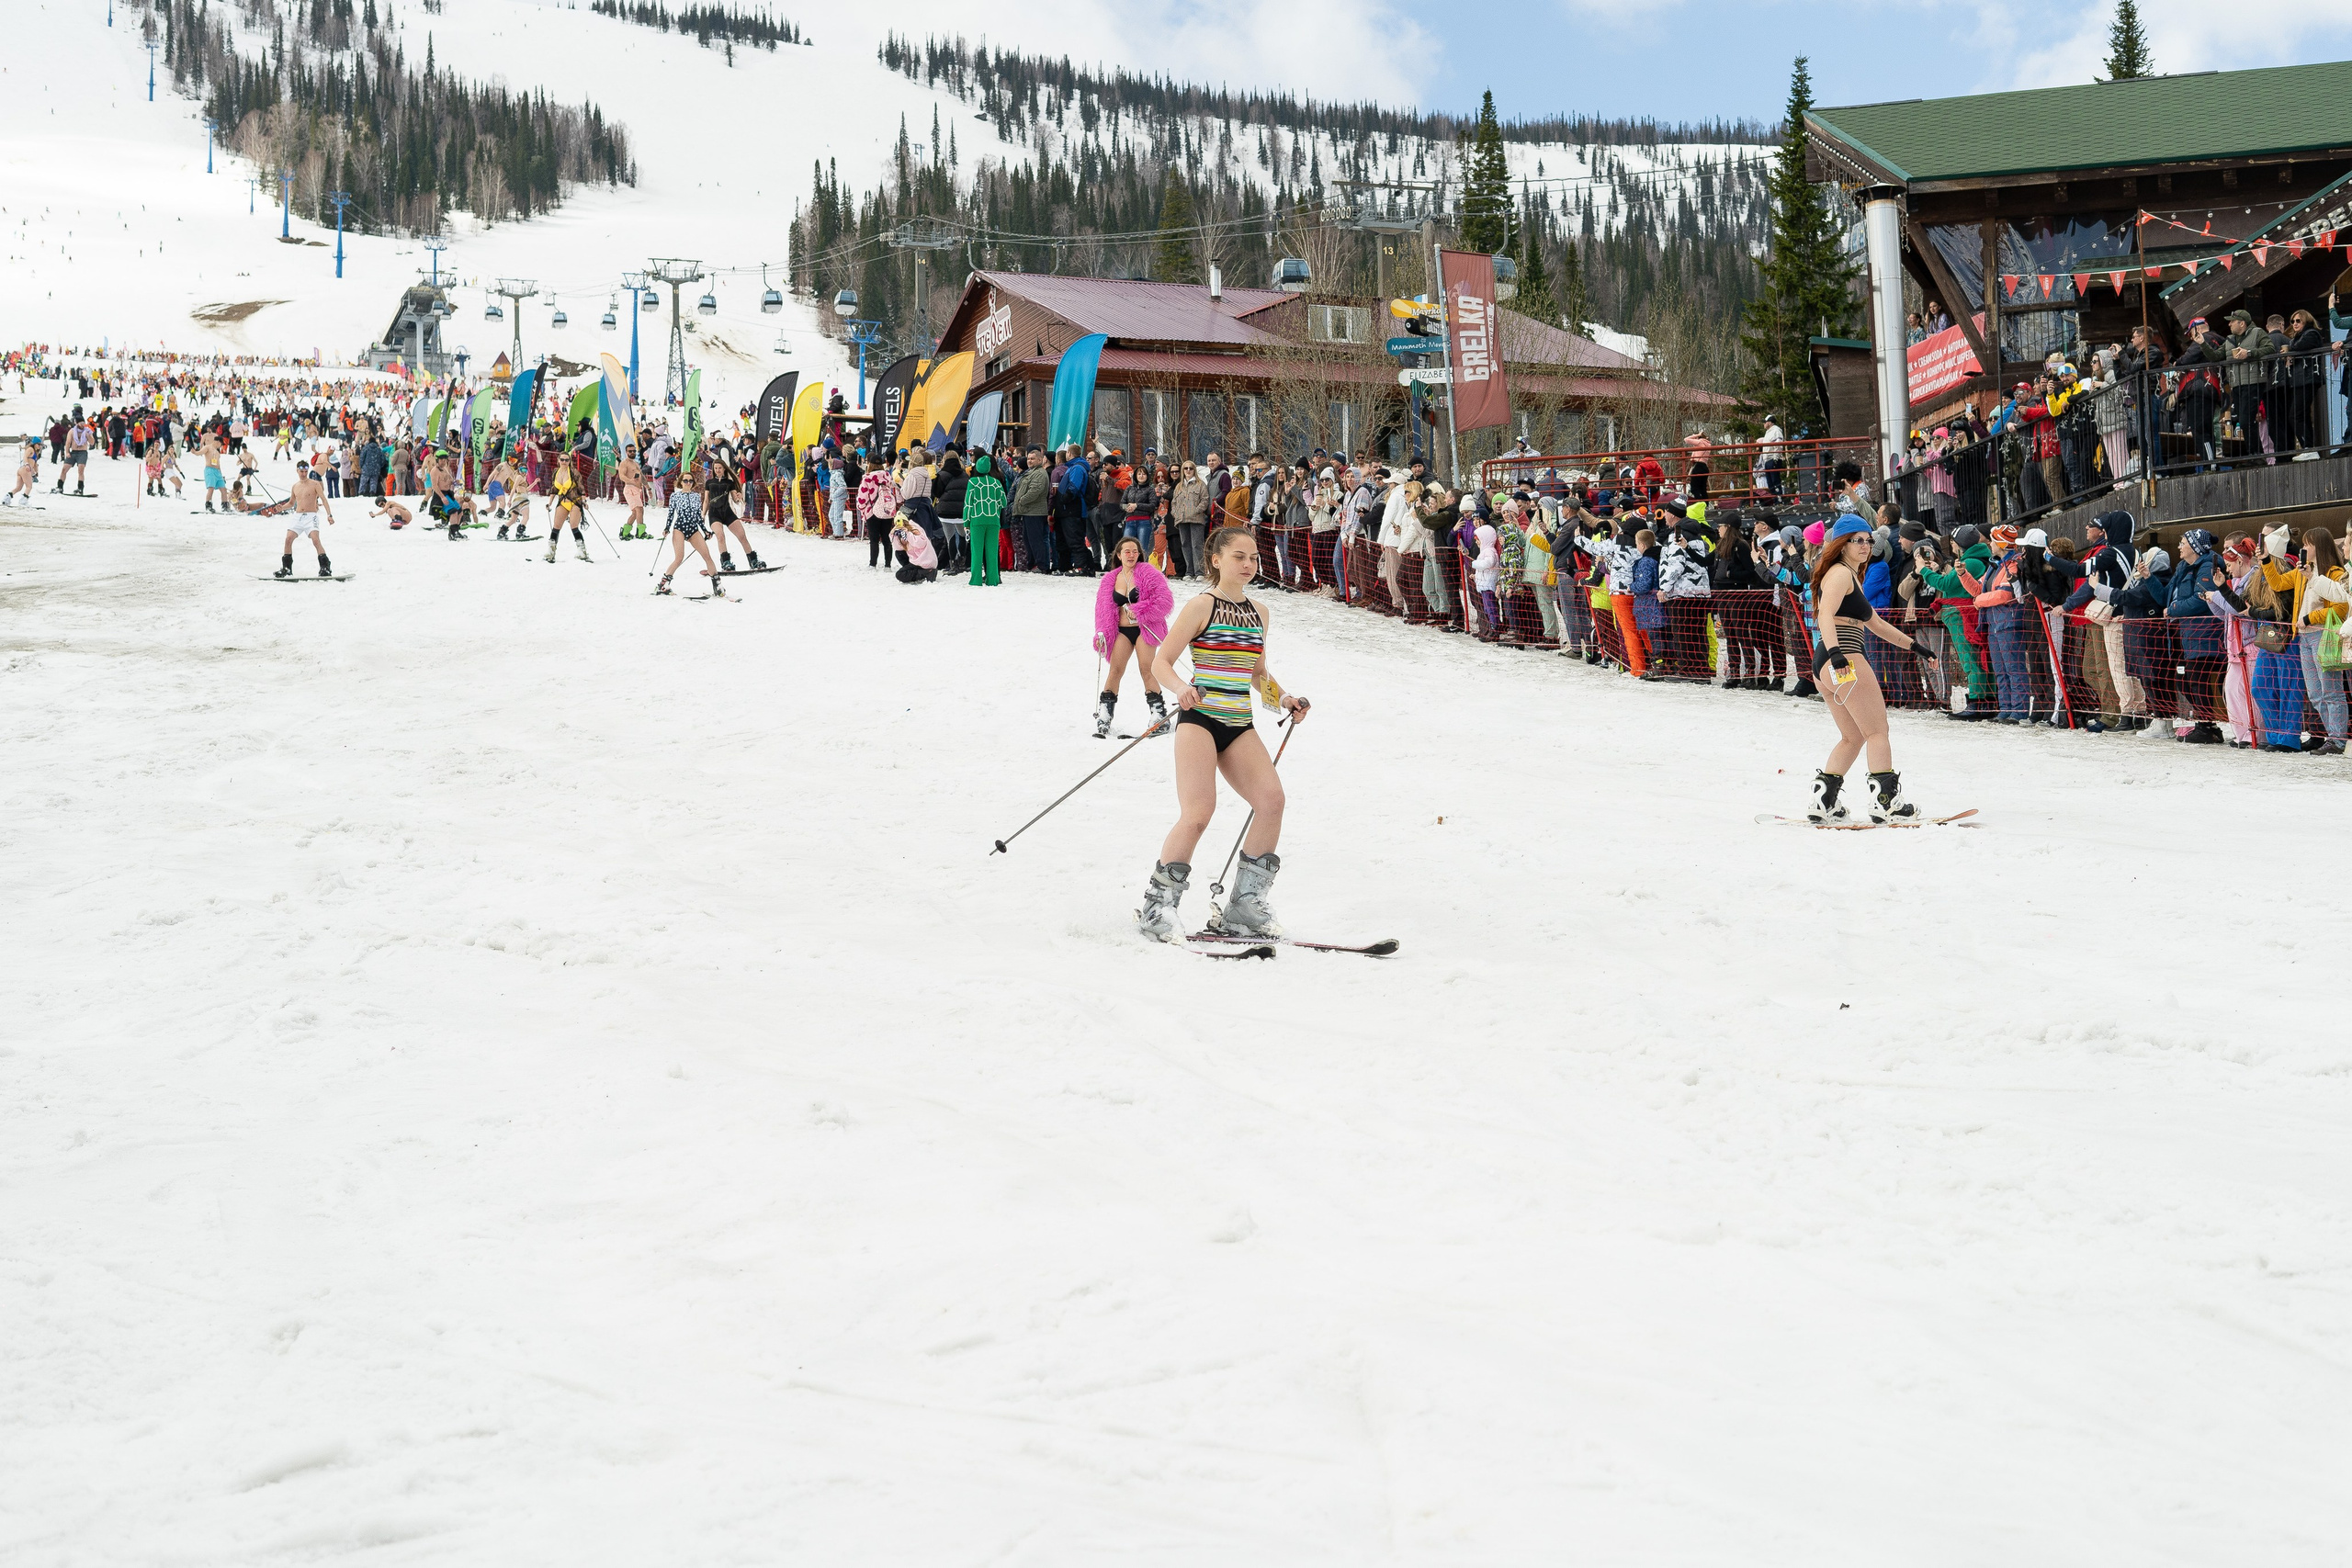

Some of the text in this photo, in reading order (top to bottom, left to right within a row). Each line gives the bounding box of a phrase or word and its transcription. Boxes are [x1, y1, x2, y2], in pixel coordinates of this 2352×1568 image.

[1383, 246, 1395, 255] 13
[1391, 343, 1426, 351] Mammoth
[1457, 295, 1489, 382] GRELKA
[769, 395, 785, 441] OTELS
